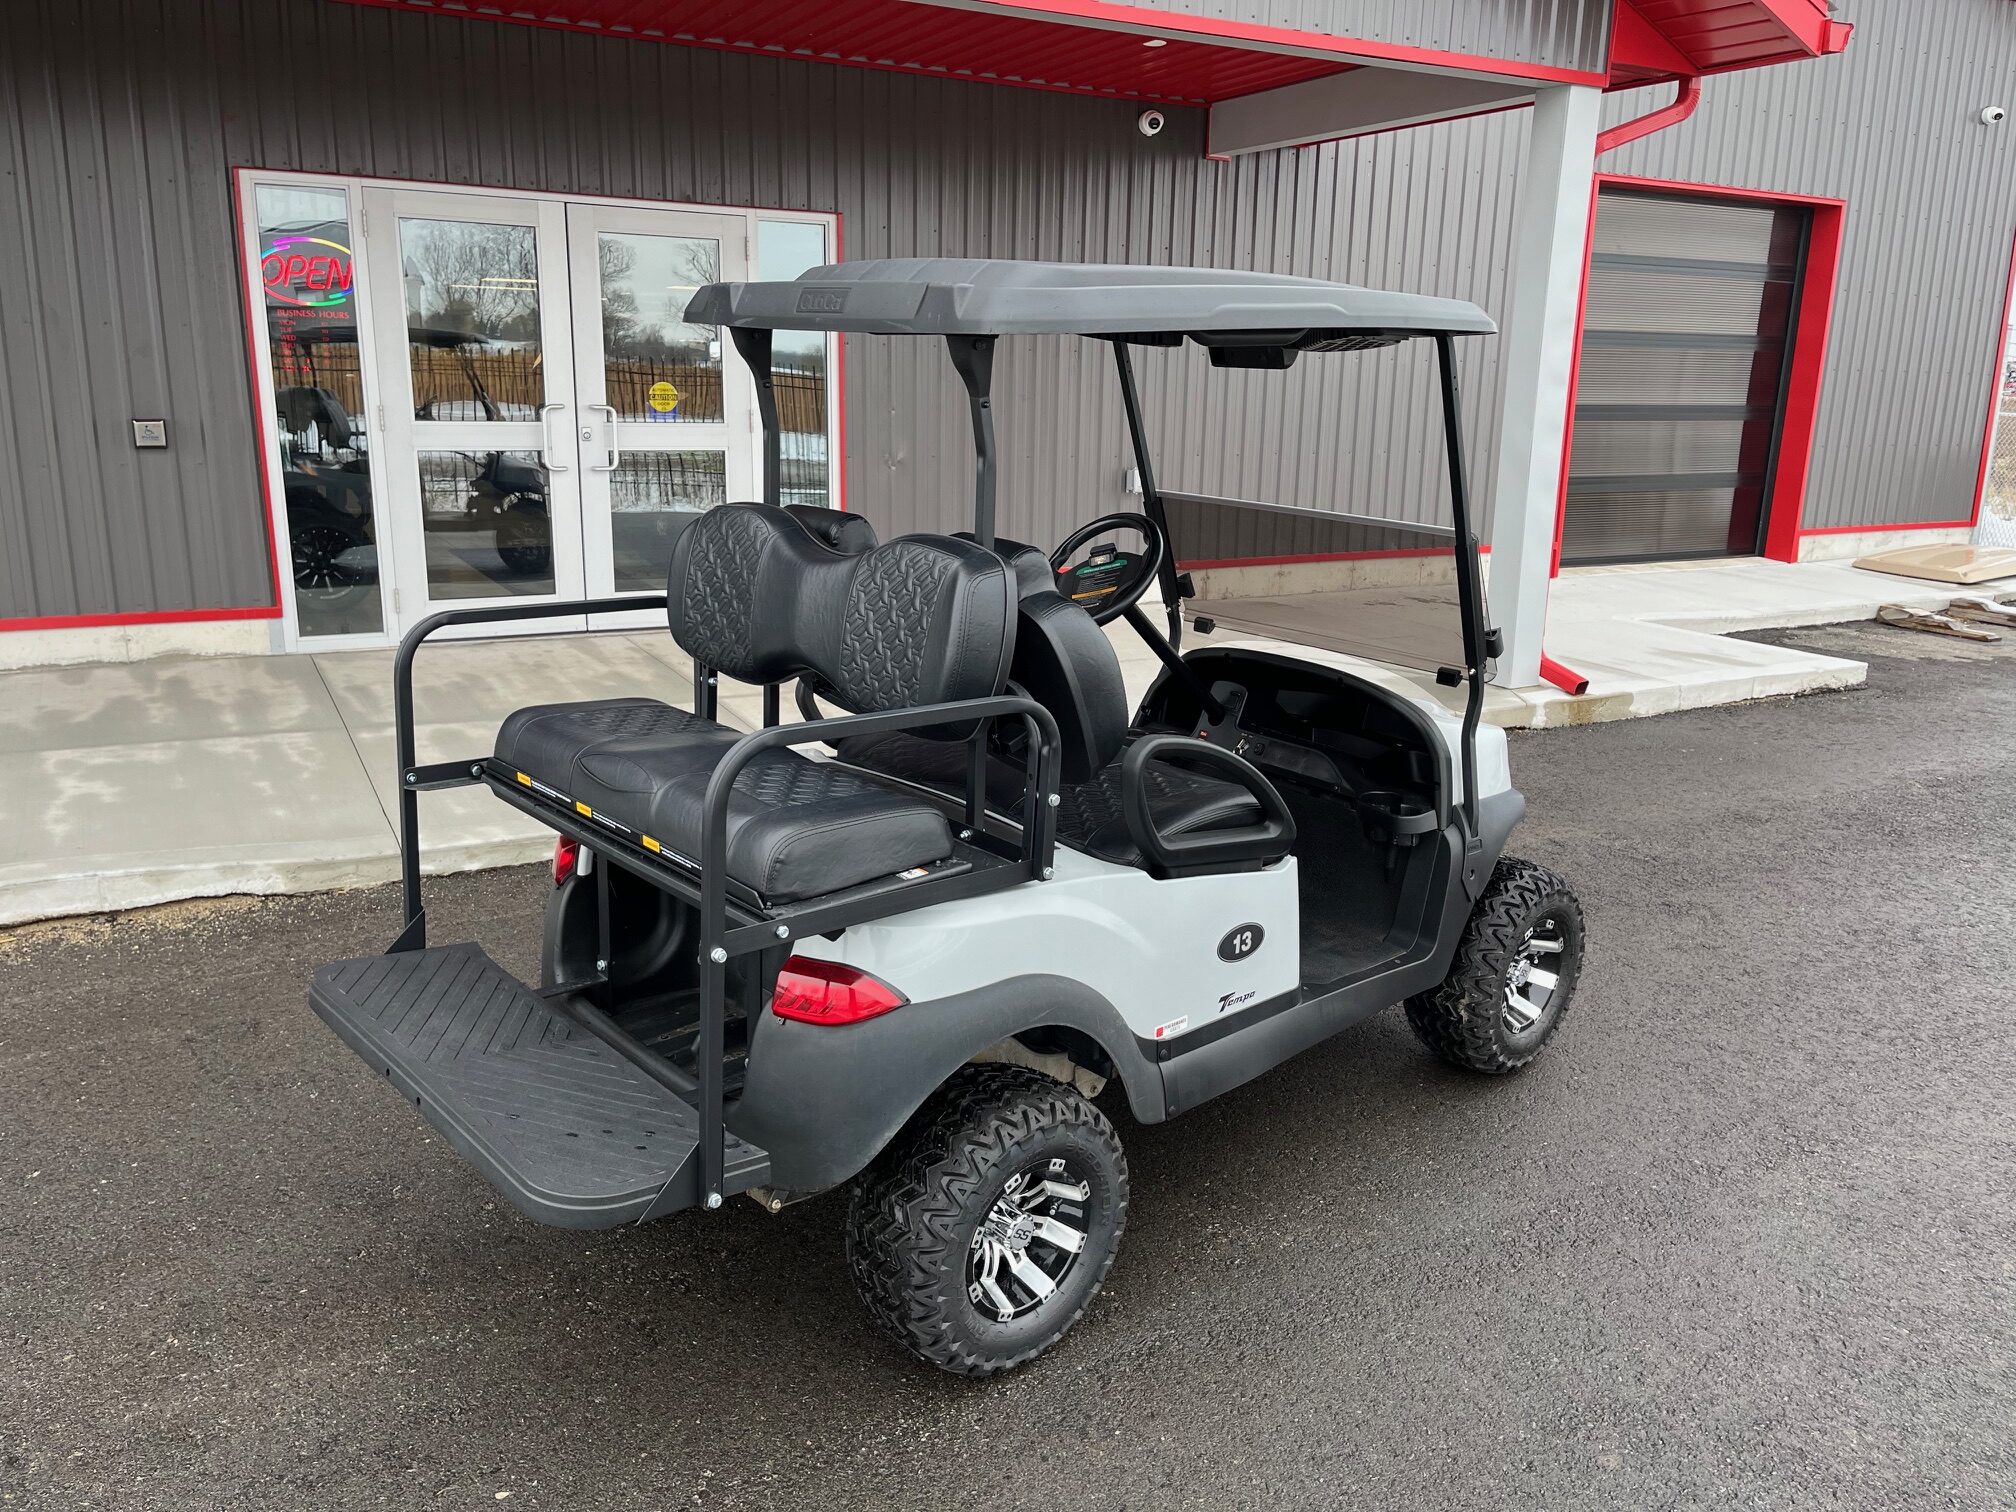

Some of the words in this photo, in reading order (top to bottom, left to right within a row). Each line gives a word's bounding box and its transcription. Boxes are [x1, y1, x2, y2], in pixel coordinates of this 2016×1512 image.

[262, 254, 352, 290] OPEN
[277, 309, 316, 318] BUSINESS
[319, 310, 350, 319] HOURS
[1233, 931, 1252, 955] 13
[1218, 991, 1256, 1014] Tempo
